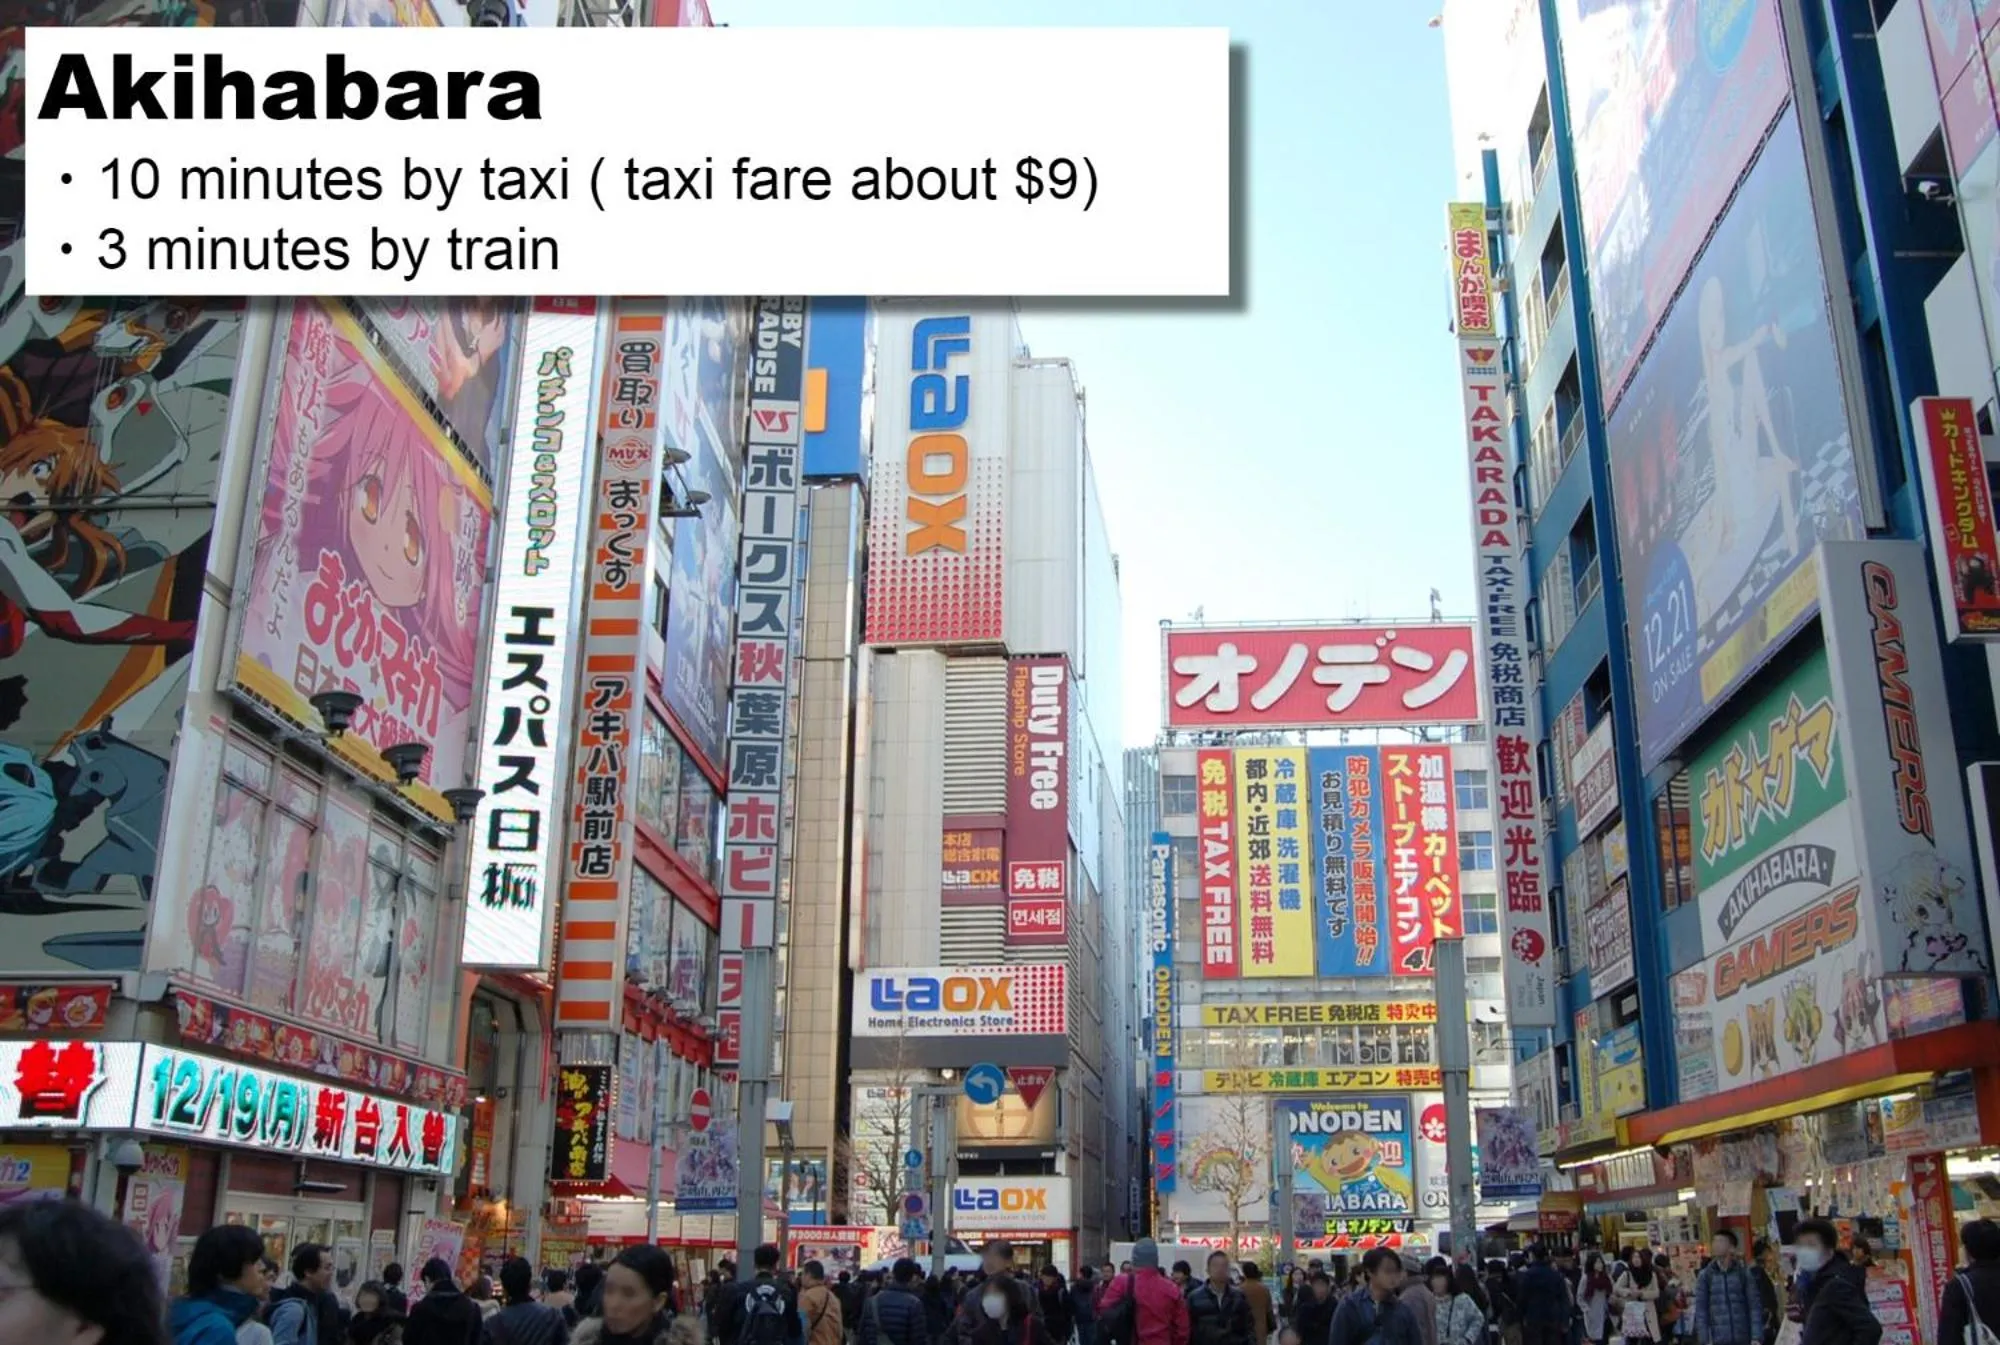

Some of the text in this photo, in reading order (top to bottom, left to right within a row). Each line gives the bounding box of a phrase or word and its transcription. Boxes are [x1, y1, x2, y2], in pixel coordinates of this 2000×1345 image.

[1455, 230, 1490, 328] まんが喫茶
[614, 341, 658, 429] 買取り
[1469, 385, 1512, 548] TAKARADA
[1943, 424, 1979, 548] カードキングダム
[604, 480, 641, 590] まっくす
[1173, 630, 1468, 712] オノデン
[1644, 580, 1691, 674] 12.21
[1010, 667, 1028, 776] Flagship Store
[1490, 642, 1527, 727] 免税商店
[1862, 560, 1935, 848] GAMERS
[579, 680, 625, 877] アキバ駅前店
[1028, 666, 1064, 810] Duty Free
[1201, 758, 1233, 965] 免税 TAX FREE
[1496, 735, 1542, 912] 歓迎光臨
[1012, 908, 1061, 926] 면세점
[1014, 867, 1060, 890] 免税
[1152, 844, 1171, 952] Panasonic
[1726, 848, 1819, 923] AKIHABARA
[1713, 885, 1860, 1000] GAMERS
[908, 1015, 976, 1029] Electronics
[980, 1015, 1014, 1027] Store
[1155, 964, 1171, 1057] ONODEN
[1213, 1006, 1259, 1024] TAX
[1265, 1005, 1323, 1022] FREE
[1328, 1004, 1380, 1021] 免税店
[1017, 1073, 1046, 1086] 止まれ
[1268, 1070, 1320, 1088] 冷蔵庫
[1326, 1070, 1390, 1086] エアコン
[1311, 1102, 1354, 1111] Welcome
